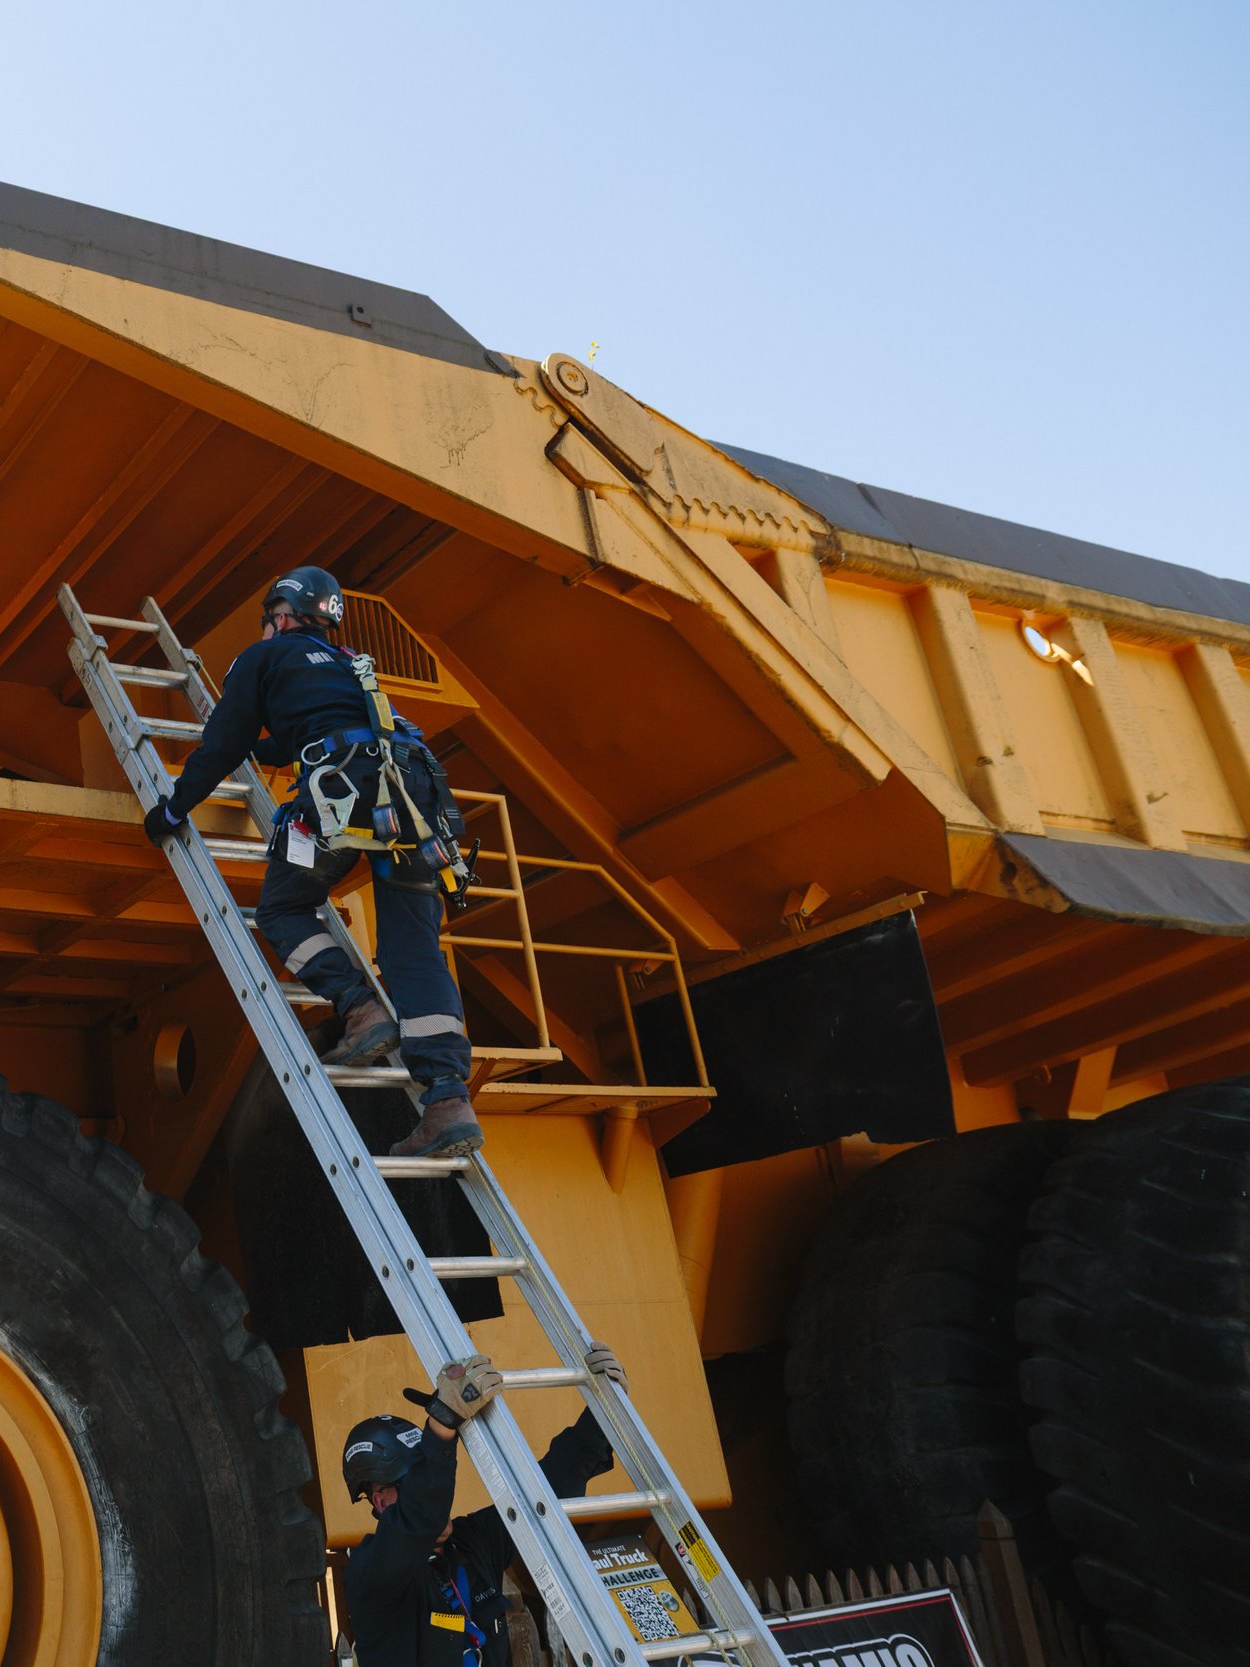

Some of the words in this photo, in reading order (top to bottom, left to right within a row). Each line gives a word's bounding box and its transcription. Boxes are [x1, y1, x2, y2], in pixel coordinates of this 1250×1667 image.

[592, 1554, 614, 1570] aul
[610, 1548, 649, 1566] Truck
[601, 1568, 660, 1587] HALLENGE
